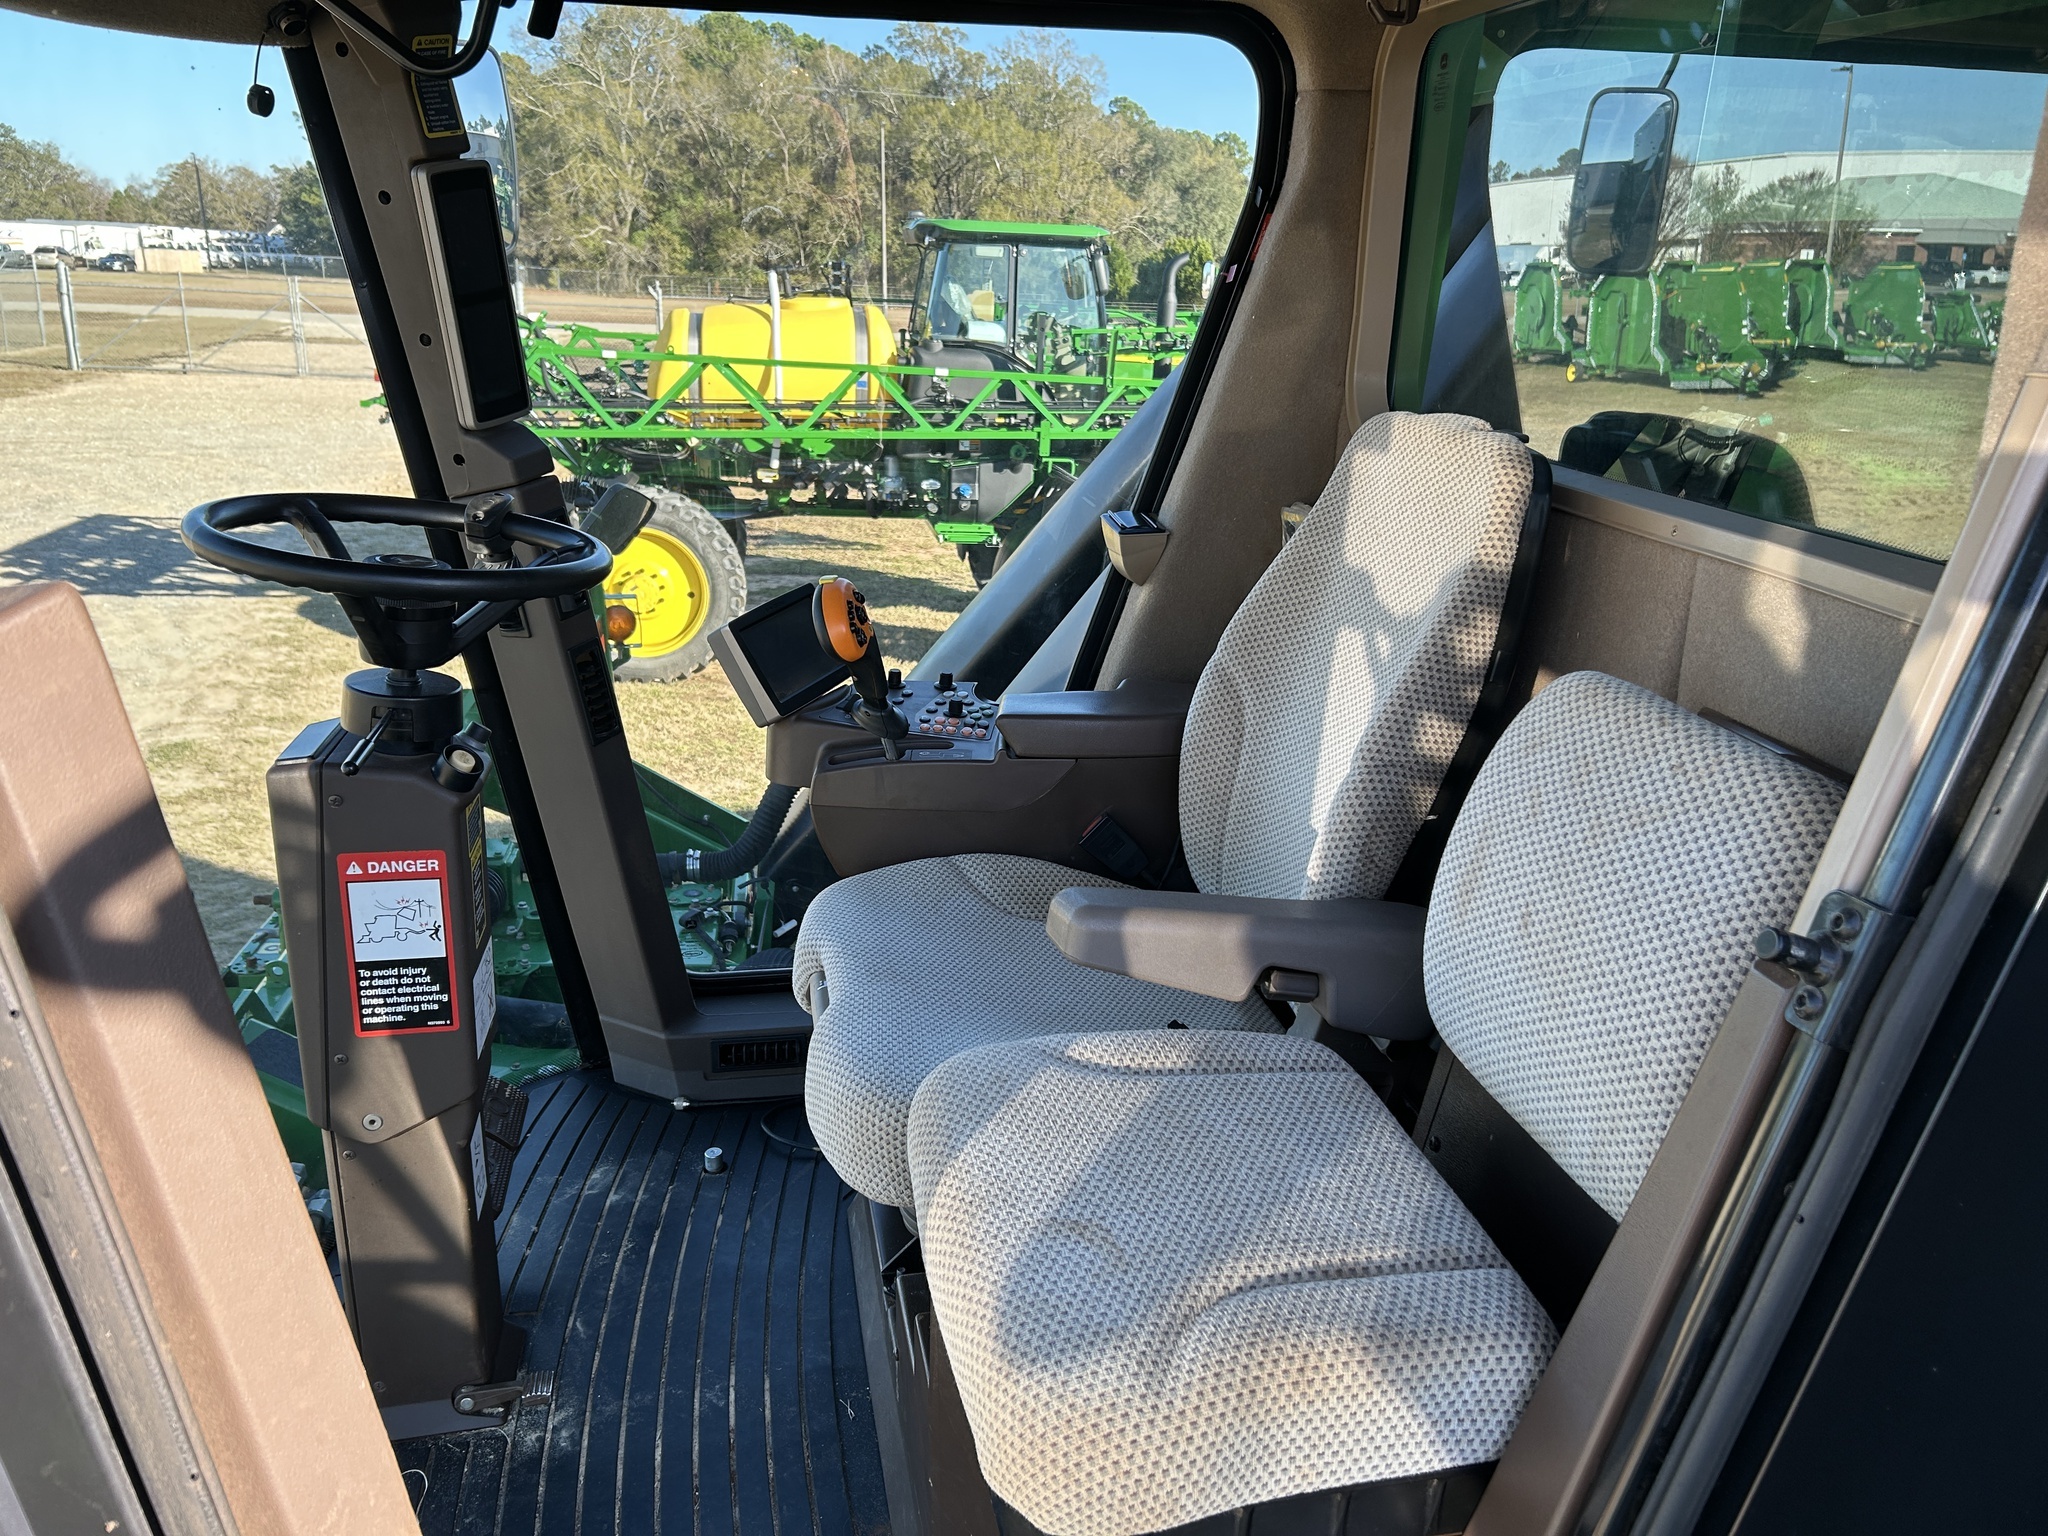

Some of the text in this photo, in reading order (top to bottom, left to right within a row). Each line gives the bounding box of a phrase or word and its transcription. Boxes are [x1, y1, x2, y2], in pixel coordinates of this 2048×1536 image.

[424, 38, 449, 46] CAUTION
[367, 860, 439, 873] DANGER
[358, 967, 427, 977] To avoid injury
[372, 977, 398, 986] death
[361, 984, 439, 996] contact electrical
[362, 993, 448, 1005] lines when moving
[374, 1005, 419, 1015] operating
[363, 1014, 406, 1023] machine.
